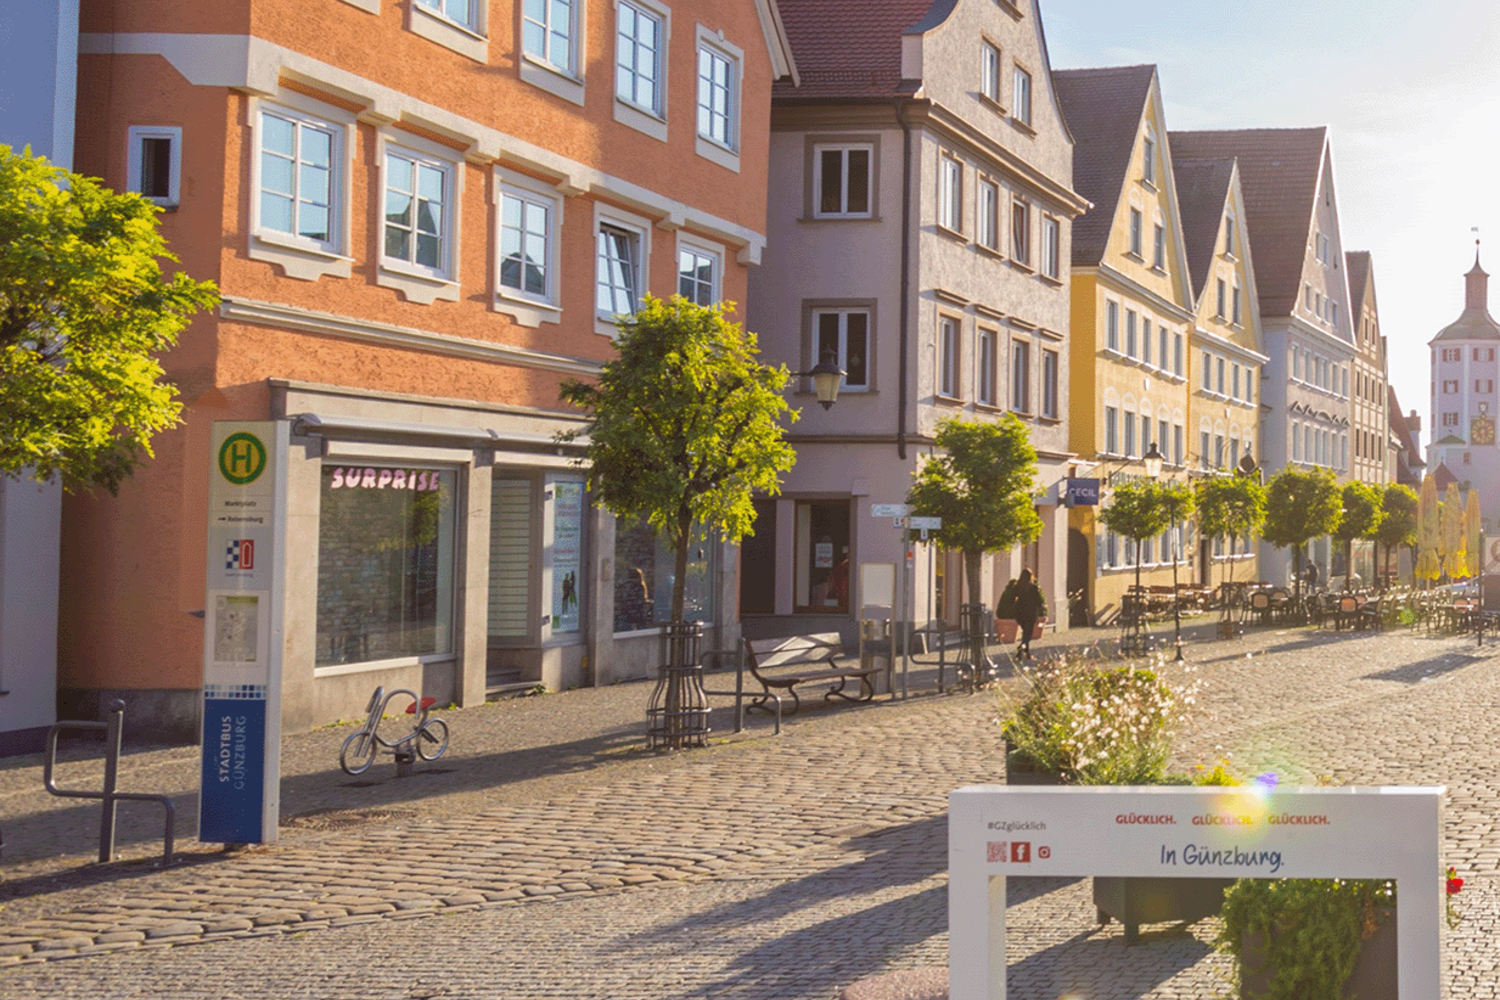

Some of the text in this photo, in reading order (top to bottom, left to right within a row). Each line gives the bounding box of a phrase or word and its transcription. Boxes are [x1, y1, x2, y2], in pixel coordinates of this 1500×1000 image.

[232, 443, 252, 473] H
[330, 467, 440, 491] SURPRISE
[1068, 487, 1097, 497] CECIL
[224, 501, 257, 509] Marktplatz
[219, 715, 232, 783] STADTBUS
[232, 715, 248, 790] GÜNZBURG
[987, 820, 1047, 833] #GZglücklich
[1115, 812, 1331, 826] GLÜCKLICH. GLÜCKLICH. GLÜCKLICH.
[1160, 843, 1285, 874] In Günzburg.
